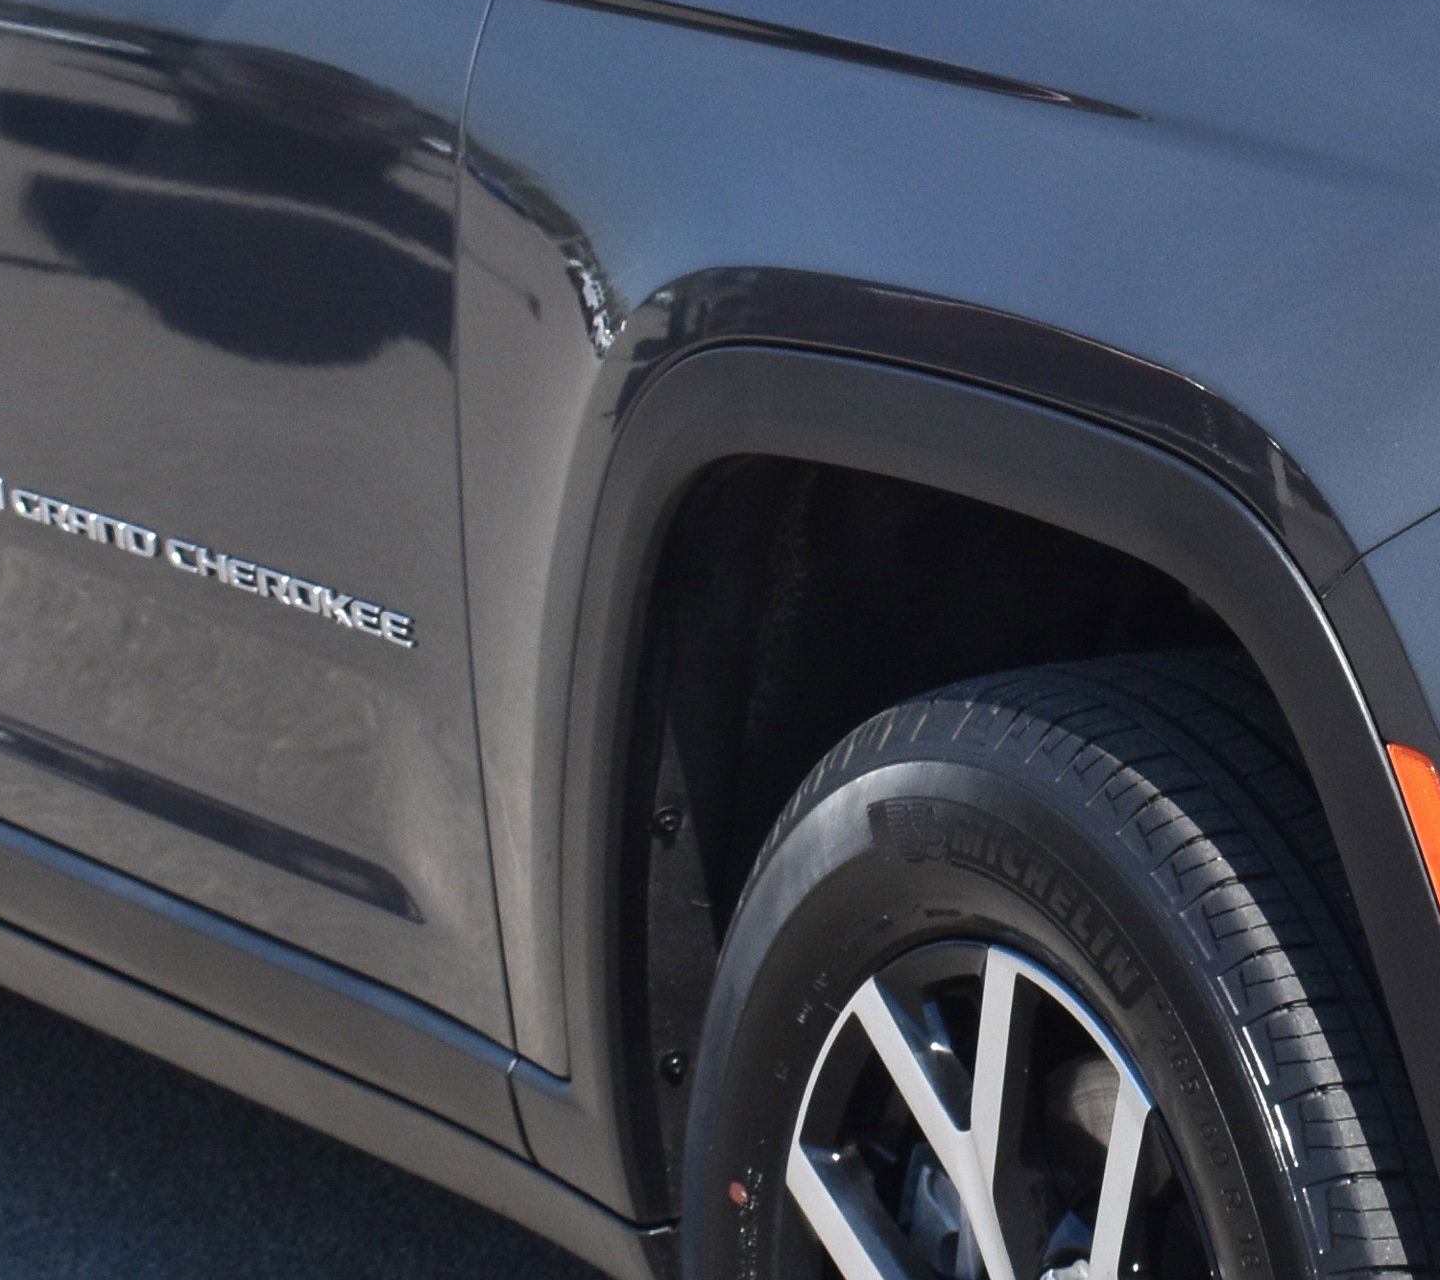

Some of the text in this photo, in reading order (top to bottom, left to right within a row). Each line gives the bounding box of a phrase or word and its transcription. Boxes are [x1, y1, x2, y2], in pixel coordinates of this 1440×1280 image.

[11, 488, 417, 649] GRAND CHEROKEE
[951, 827, 1142, 996] MICHELIN
